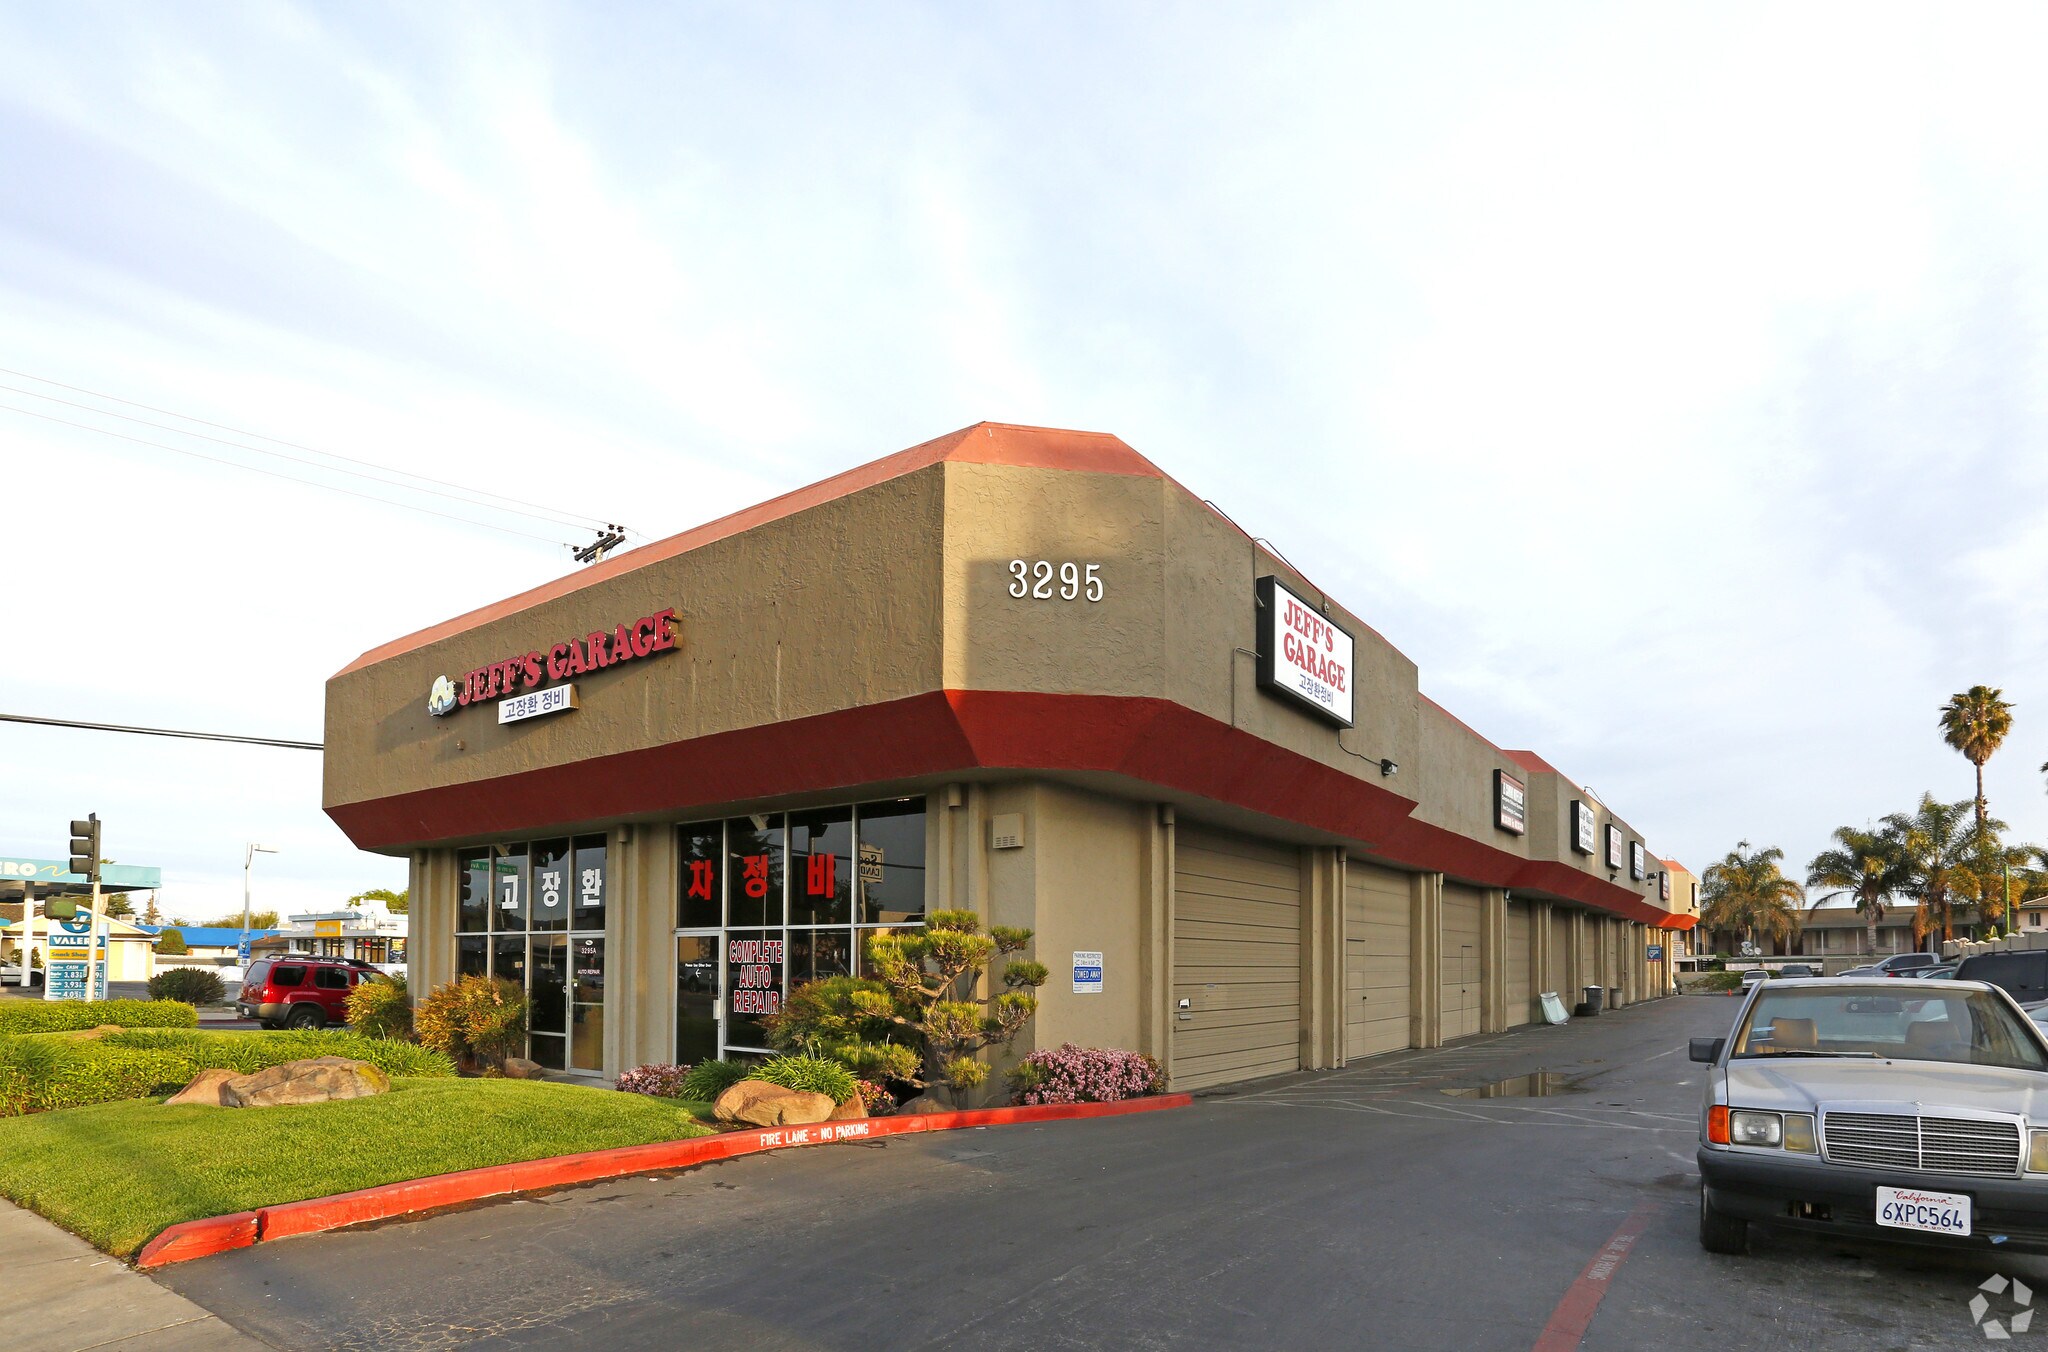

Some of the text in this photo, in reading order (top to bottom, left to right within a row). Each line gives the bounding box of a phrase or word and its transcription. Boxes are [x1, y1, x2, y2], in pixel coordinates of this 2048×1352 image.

[1009, 560, 1104, 602] 3295
[1284, 599, 1333, 653] JEFF'S
[458, 607, 677, 706] JEFF'S GARAGE
[1284, 632, 1346, 693] GARAGE
[505, 687, 565, 719] 고장환 정비
[729, 940, 783, 963] COMPLETE
[739, 965, 772, 989] AUTO
[1074, 970, 1101, 978] TOWED AWAY
[733, 990, 779, 1015] REPAIR
[760, 1132, 781, 1147] FIRE
[785, 1129, 809, 1144] LANE
[820, 1127, 833, 1140] NO
[835, 1123, 869, 1139] PARKING
[1896, 1190, 1953, 1205] California
[1883, 1202, 1963, 1229] 6XPC564
